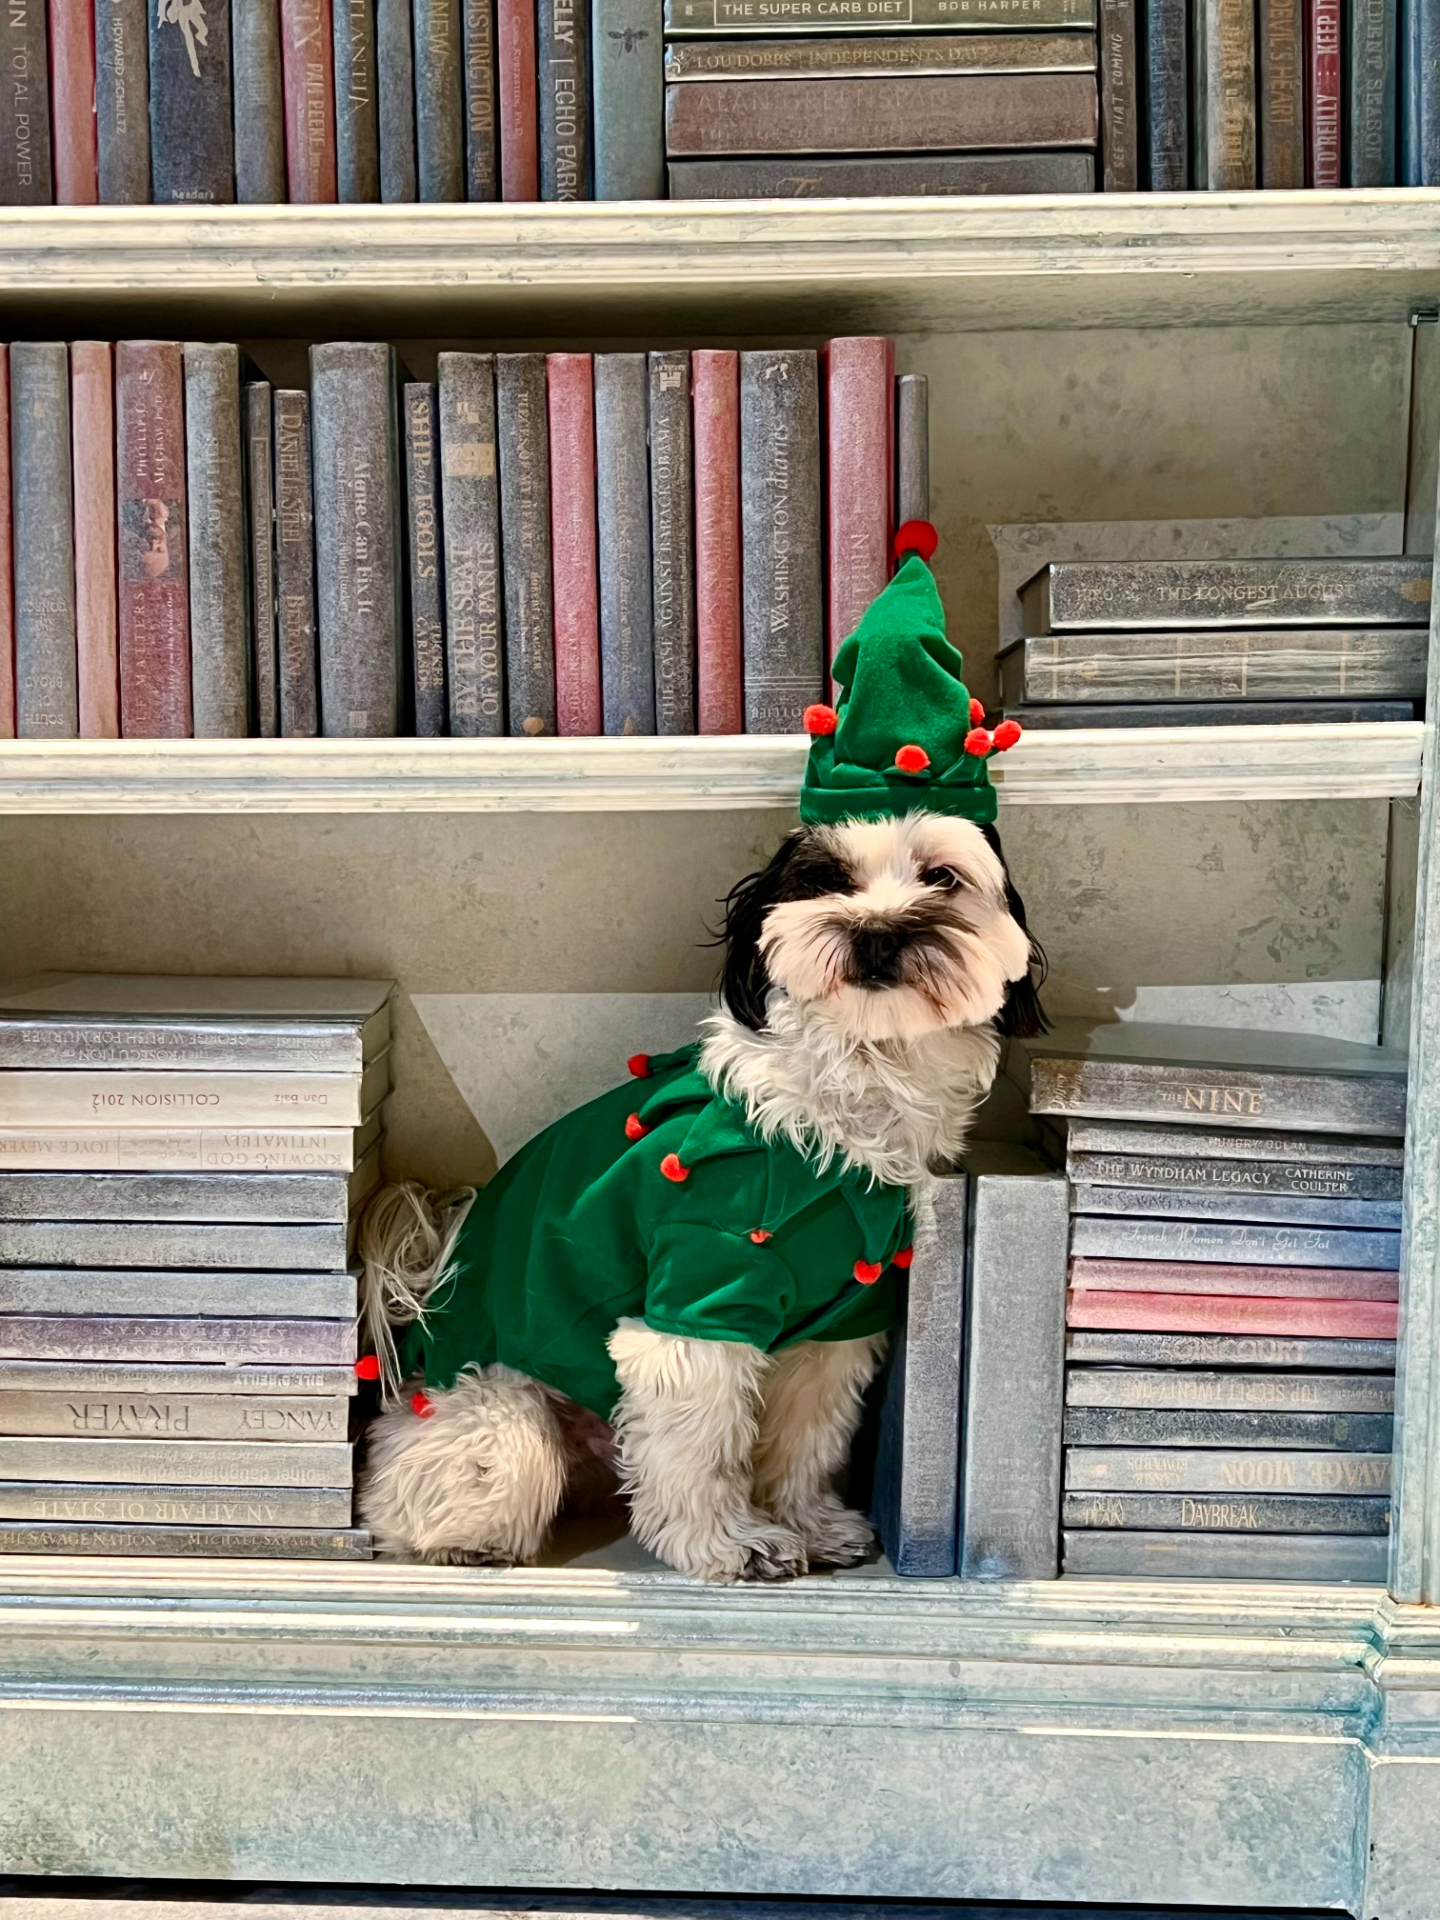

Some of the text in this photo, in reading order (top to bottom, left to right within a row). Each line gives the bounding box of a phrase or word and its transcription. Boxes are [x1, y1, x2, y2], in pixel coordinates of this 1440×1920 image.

[723, 1, 902, 15] THE SUPER CARB DIET
[938, 0, 1042, 11] BOB HARPER
[1269, 0, 1295, 61] DEVIL'S
[1316, 14, 1338, 54] KEEP
[112, 17, 126, 134] HOWARD SCHULTZ
[1111, 33, 1125, 168] SEE THAT COMING
[1270, 65, 1295, 126] HEART
[12, 46, 32, 186] TOTAL POWER
[310, 100, 326, 146] PEEKE
[1316, 94, 1338, 161] O'REILLY
[1366, 79, 1384, 159] SEASON
[554, 78, 578, 202] ECHO PARK
[171, 189, 215, 200] Reader's
[136, 417, 147, 477] PHILLIP
[764, 422, 788, 490] diaries
[280, 413, 303, 546] DANIELLE STEEL
[411, 401, 436, 579] SHIP of FOOLS
[353, 460, 373, 614] Alone Can Fix It
[657, 417, 676, 716] THE CASE AGAINST BARACK OBAMA
[771, 496, 790, 634] WASHINGTON
[1157, 583, 1357, 600] THE LONGEST AUGUST
[133, 592, 147, 685] MATTERS
[450, 542, 477, 715] BY THE SEAT
[477, 541, 500, 716] OF YOUR PANTS
[416, 616, 431, 691] CARLSON
[430, 621, 443, 687] TUCKER
[24, 676, 64, 688] BROAD
[21, 1029, 89, 1043] MURDER
[90, 1030, 122, 1044] FOR
[126, 1031, 166, 1044] BUSH
[187, 1031, 249, 1045] GEORGE
[79, 1048, 187, 1062] PROSECUTION
[92, 1093, 221, 1107] COLLISION 2012
[273, 1093, 328, 1105] Dan Balz
[1162, 1088, 1266, 1116] THE NINE
[0, 1139, 53, 1153] MEYER
[59, 1139, 111, 1154] JOYCE
[220, 1134, 327, 1149] INTIMATELY
[206, 1151, 248, 1166] GOD
[254, 1152, 343, 1166] KNOWING
[1095, 1162, 1272, 1186] THE WYNDHAM LEGACY
[1285, 1168, 1355, 1182] CATHERINE
[1291, 1180, 1350, 1193] COULTER
[1121, 1225, 1330, 1250] French Women Don't Get Fat
[223, 1327, 288, 1338] ALICE
[91, 1371, 179, 1386] Looking Out
[297, 1375, 324, 1387] BILL
[1227, 1382, 1287, 1403] SECRET
[1291, 1383, 1321, 1404] TOP
[65, 1402, 190, 1433] PRAYER
[237, 1408, 337, 1432] YANCEY
[1126, 1456, 1188, 1472] EDWARDS
[1219, 1459, 1392, 1487] AVAGE MOON
[33, 1500, 280, 1521] AN AFFAIR OF STATE
[1181, 1498, 1259, 1529] DAYBREAK
[28, 1532, 89, 1546] SAVAGE
